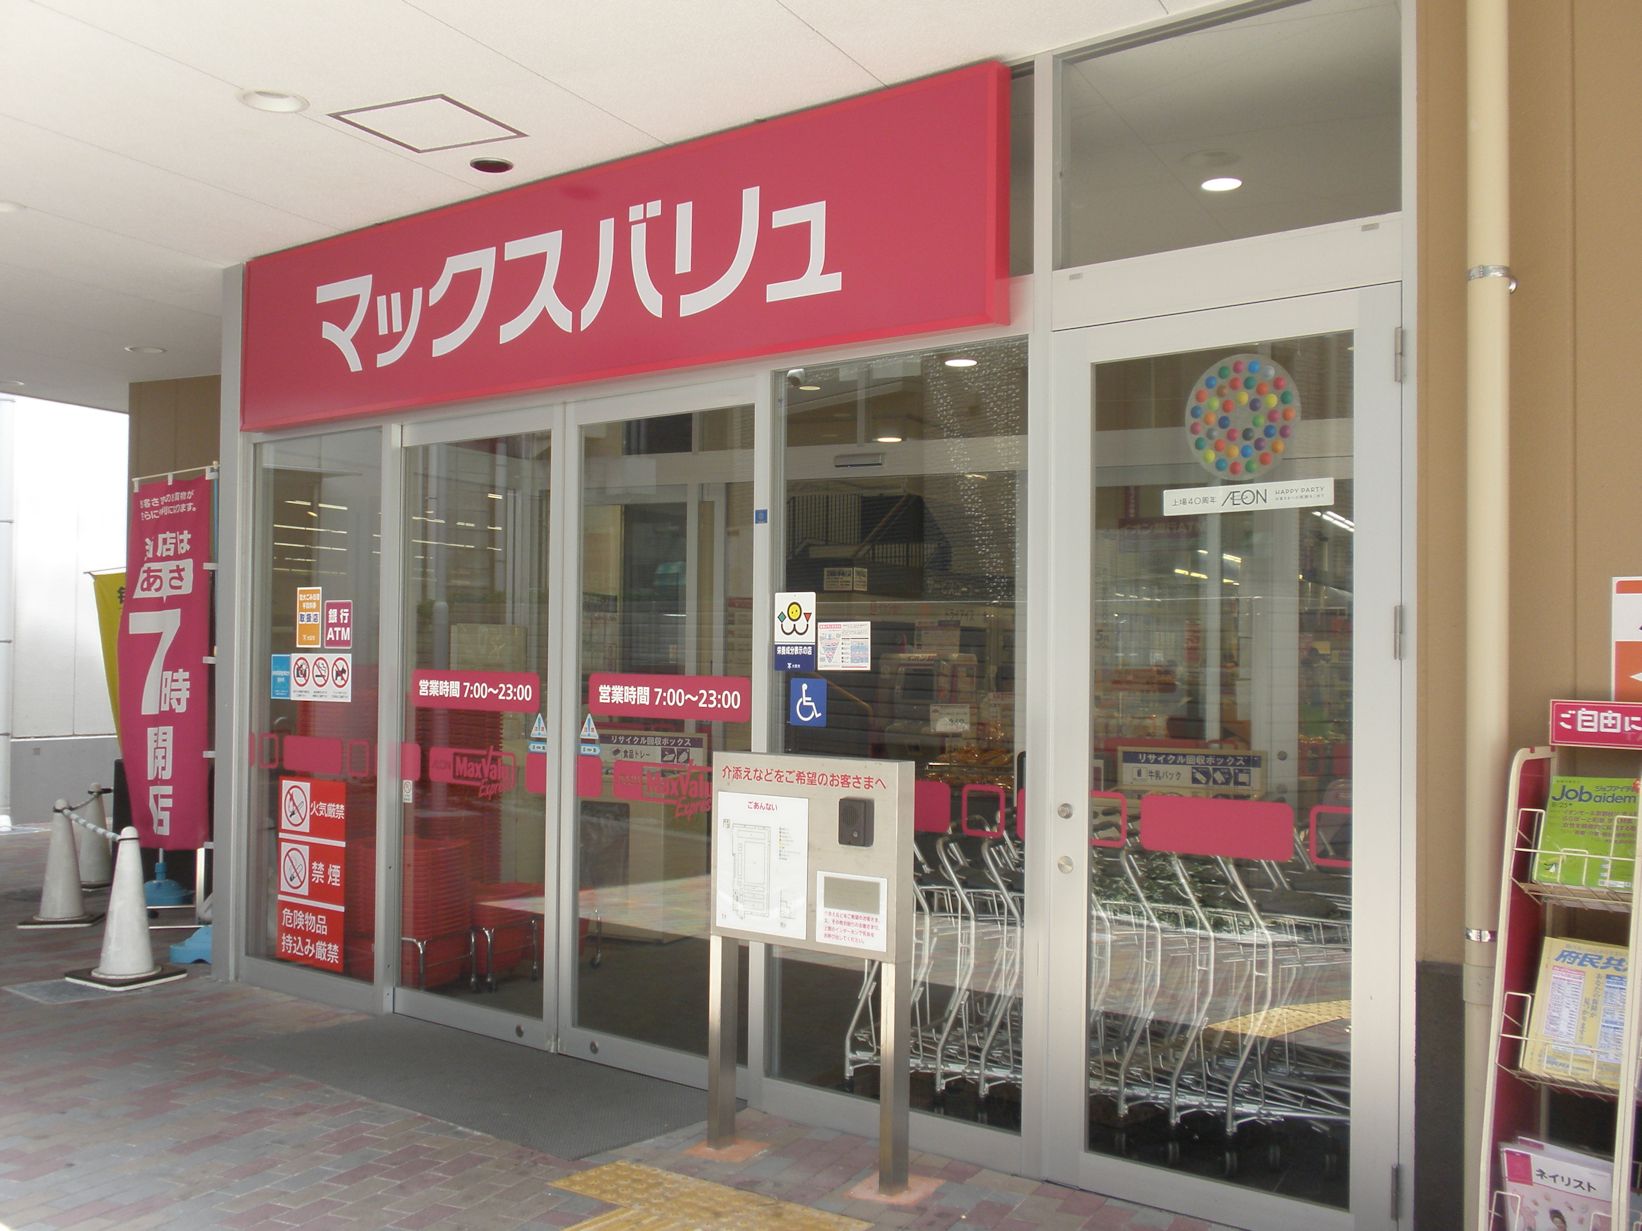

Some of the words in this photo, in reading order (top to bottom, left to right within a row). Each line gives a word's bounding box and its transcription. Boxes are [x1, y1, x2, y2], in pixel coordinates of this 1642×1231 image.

[316, 186, 842, 372] マックスバリュ
[140, 565, 186, 593] あさ
[328, 609, 349, 623] 銀行
[326, 627, 351, 641] ATM
[419, 680, 460, 698] 営業時間
[599, 685, 650, 705] 営業時間
[611, 735, 692, 747] リサイクル回収ボックス
[1138, 753, 1246, 766] リサイクル回収ボックス
[722, 765, 887, 790] 介添えなどをご希望のお客さまへ
[1551, 785, 1593, 803] Job
[1593, 793, 1637, 804] aidem
[310, 801, 345, 820] 火気厳禁
[747, 800, 778, 812] ごあんない
[311, 862, 341, 887] 禁煙
[282, 908, 328, 935] 危険物品
[281, 934, 339, 964] 持込み厳禁
[1535, 1168, 1598, 1193] ネイリスト
